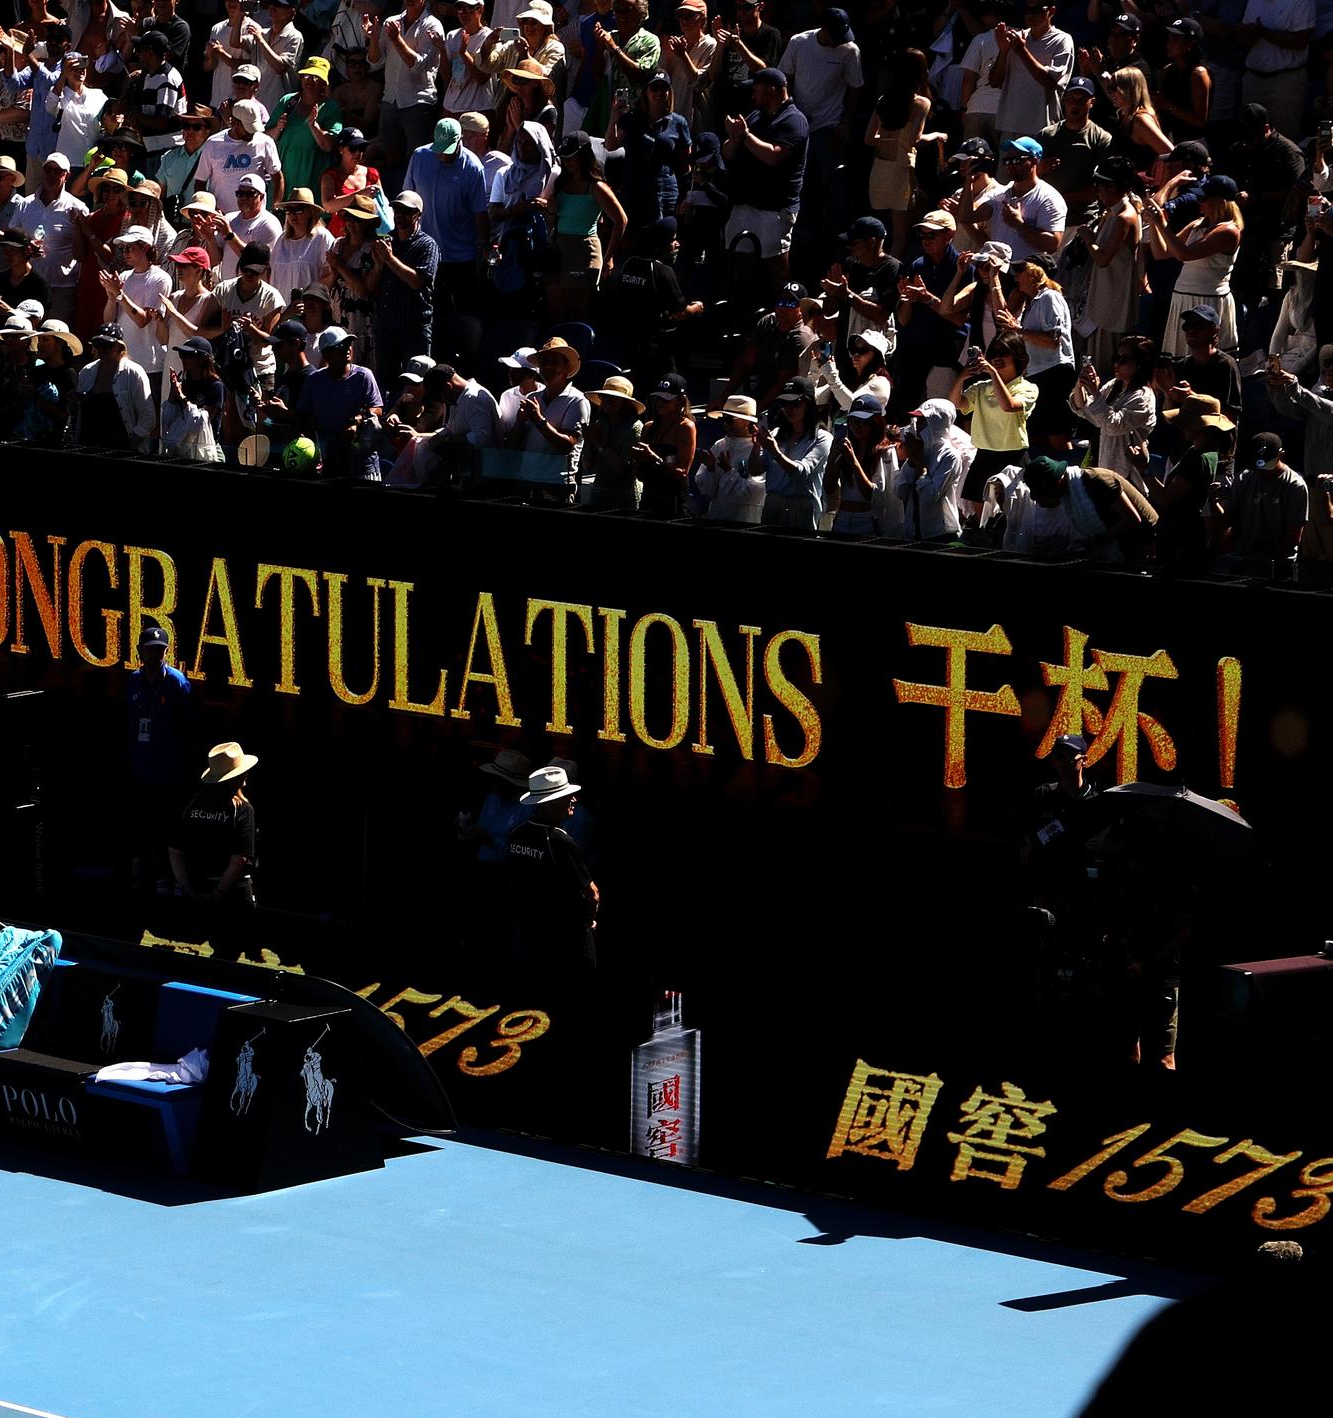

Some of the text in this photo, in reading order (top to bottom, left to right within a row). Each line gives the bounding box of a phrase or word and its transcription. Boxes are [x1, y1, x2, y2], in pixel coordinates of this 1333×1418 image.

[190, 809, 229, 823] SECURITY
[2, 1084, 77, 1126] POLO
[826, 1057, 1333, 1231] 國窖 1573
